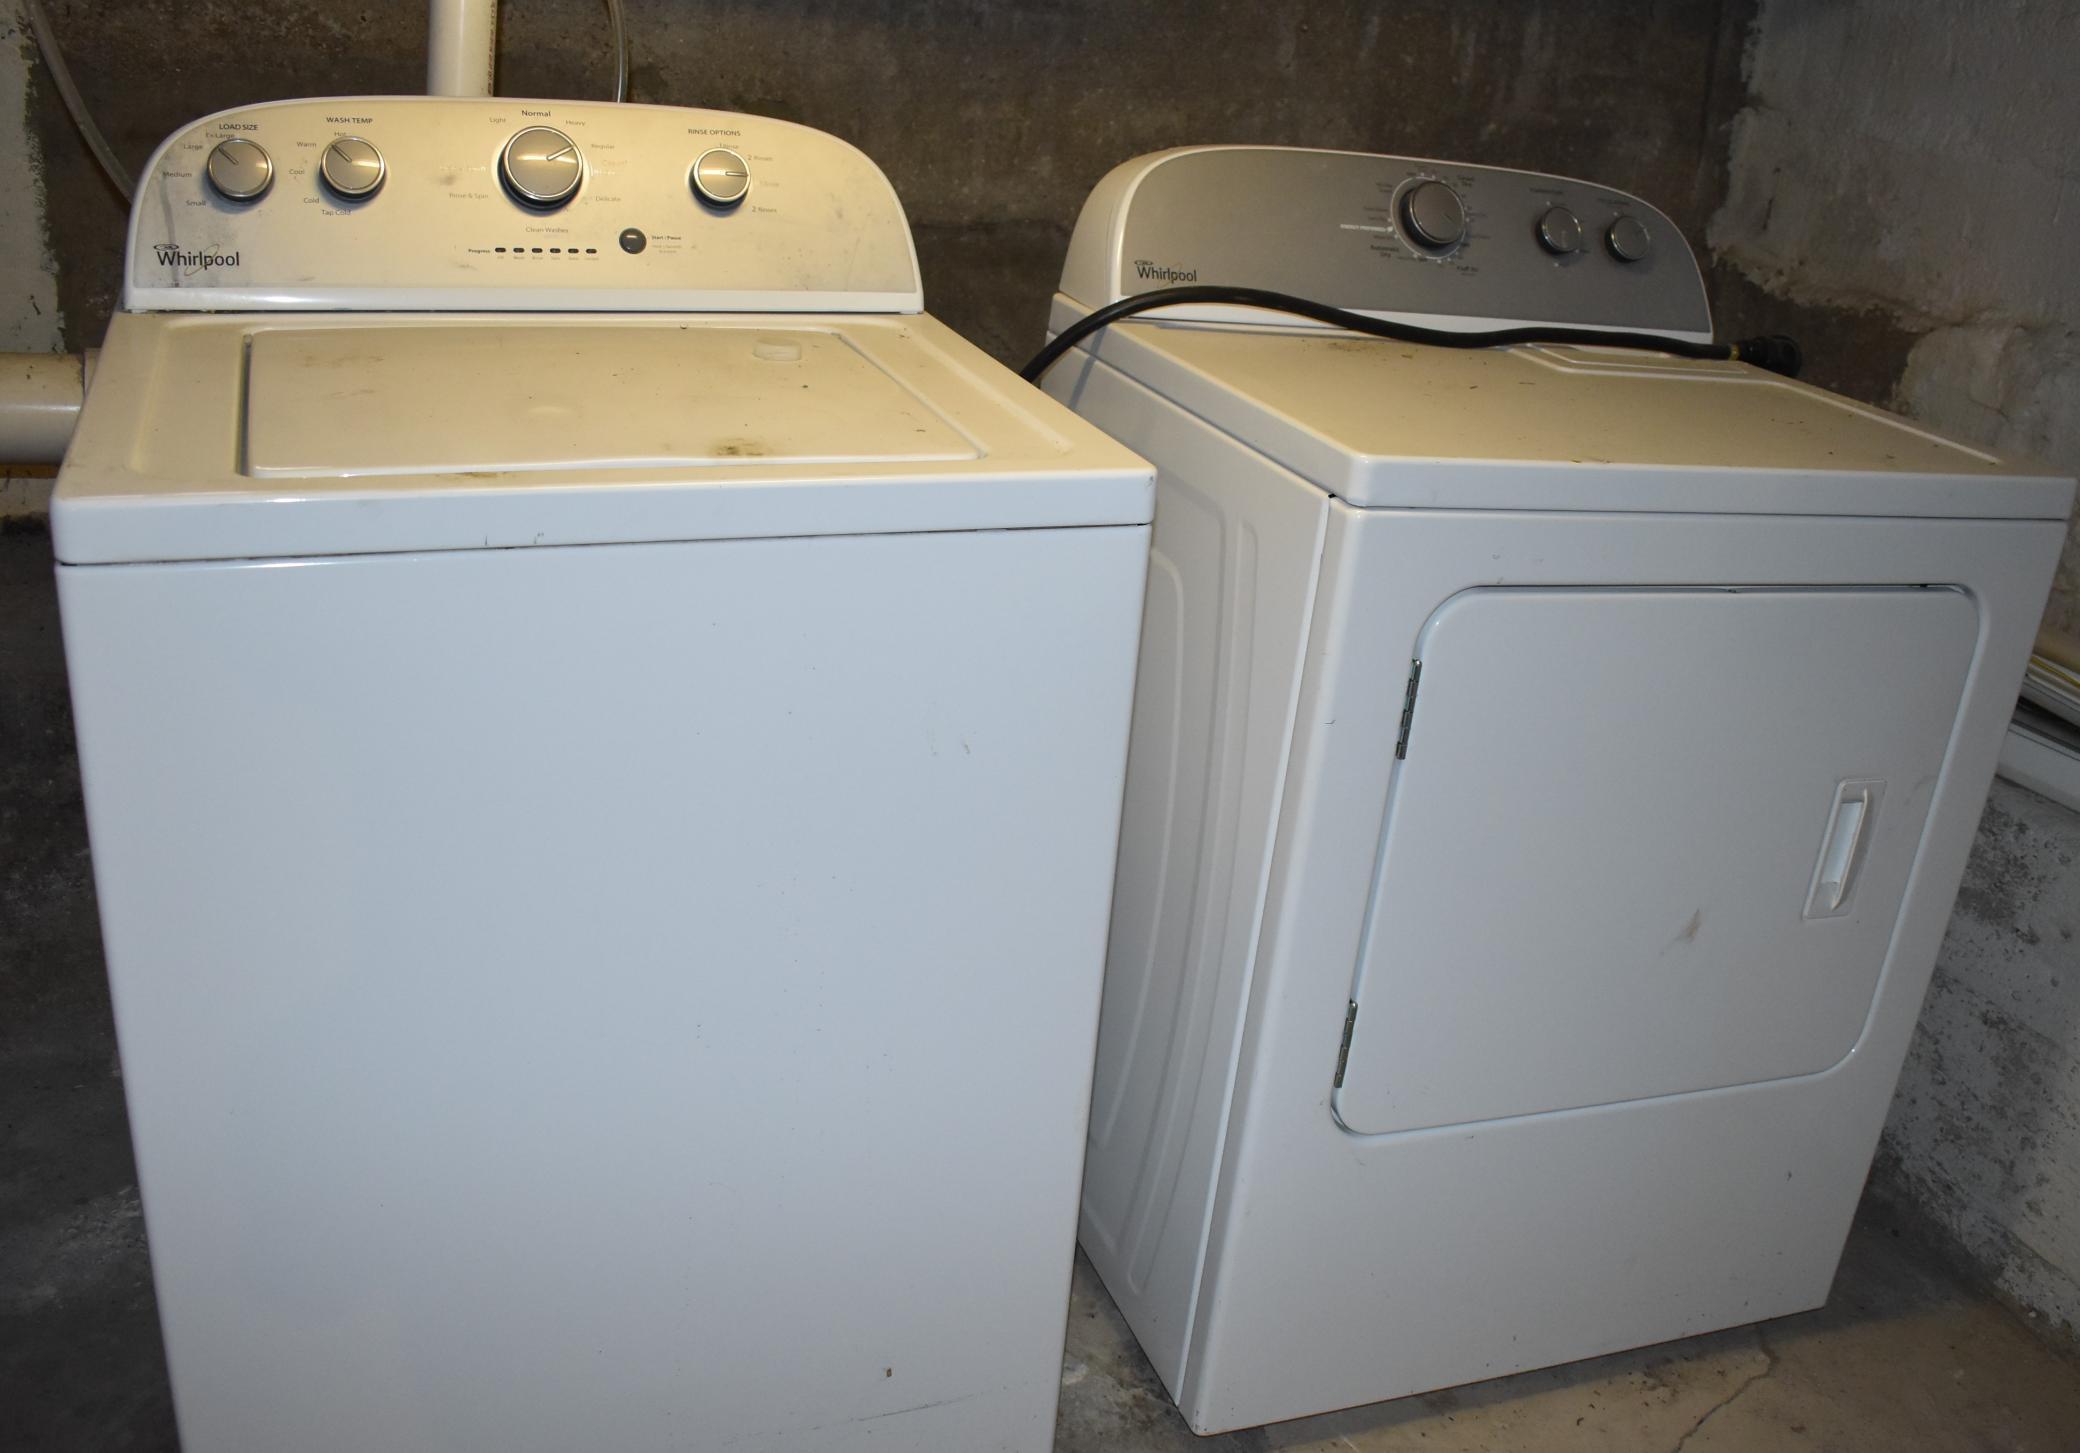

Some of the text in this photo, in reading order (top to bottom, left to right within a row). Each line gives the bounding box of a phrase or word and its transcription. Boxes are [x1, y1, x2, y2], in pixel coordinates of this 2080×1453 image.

[521, 109, 551, 117] Normal
[688, 128, 741, 137] RINSE OPTIONS
[157, 251, 240, 270] Whirlpool
[1137, 265, 1197, 284] Whirlpool
